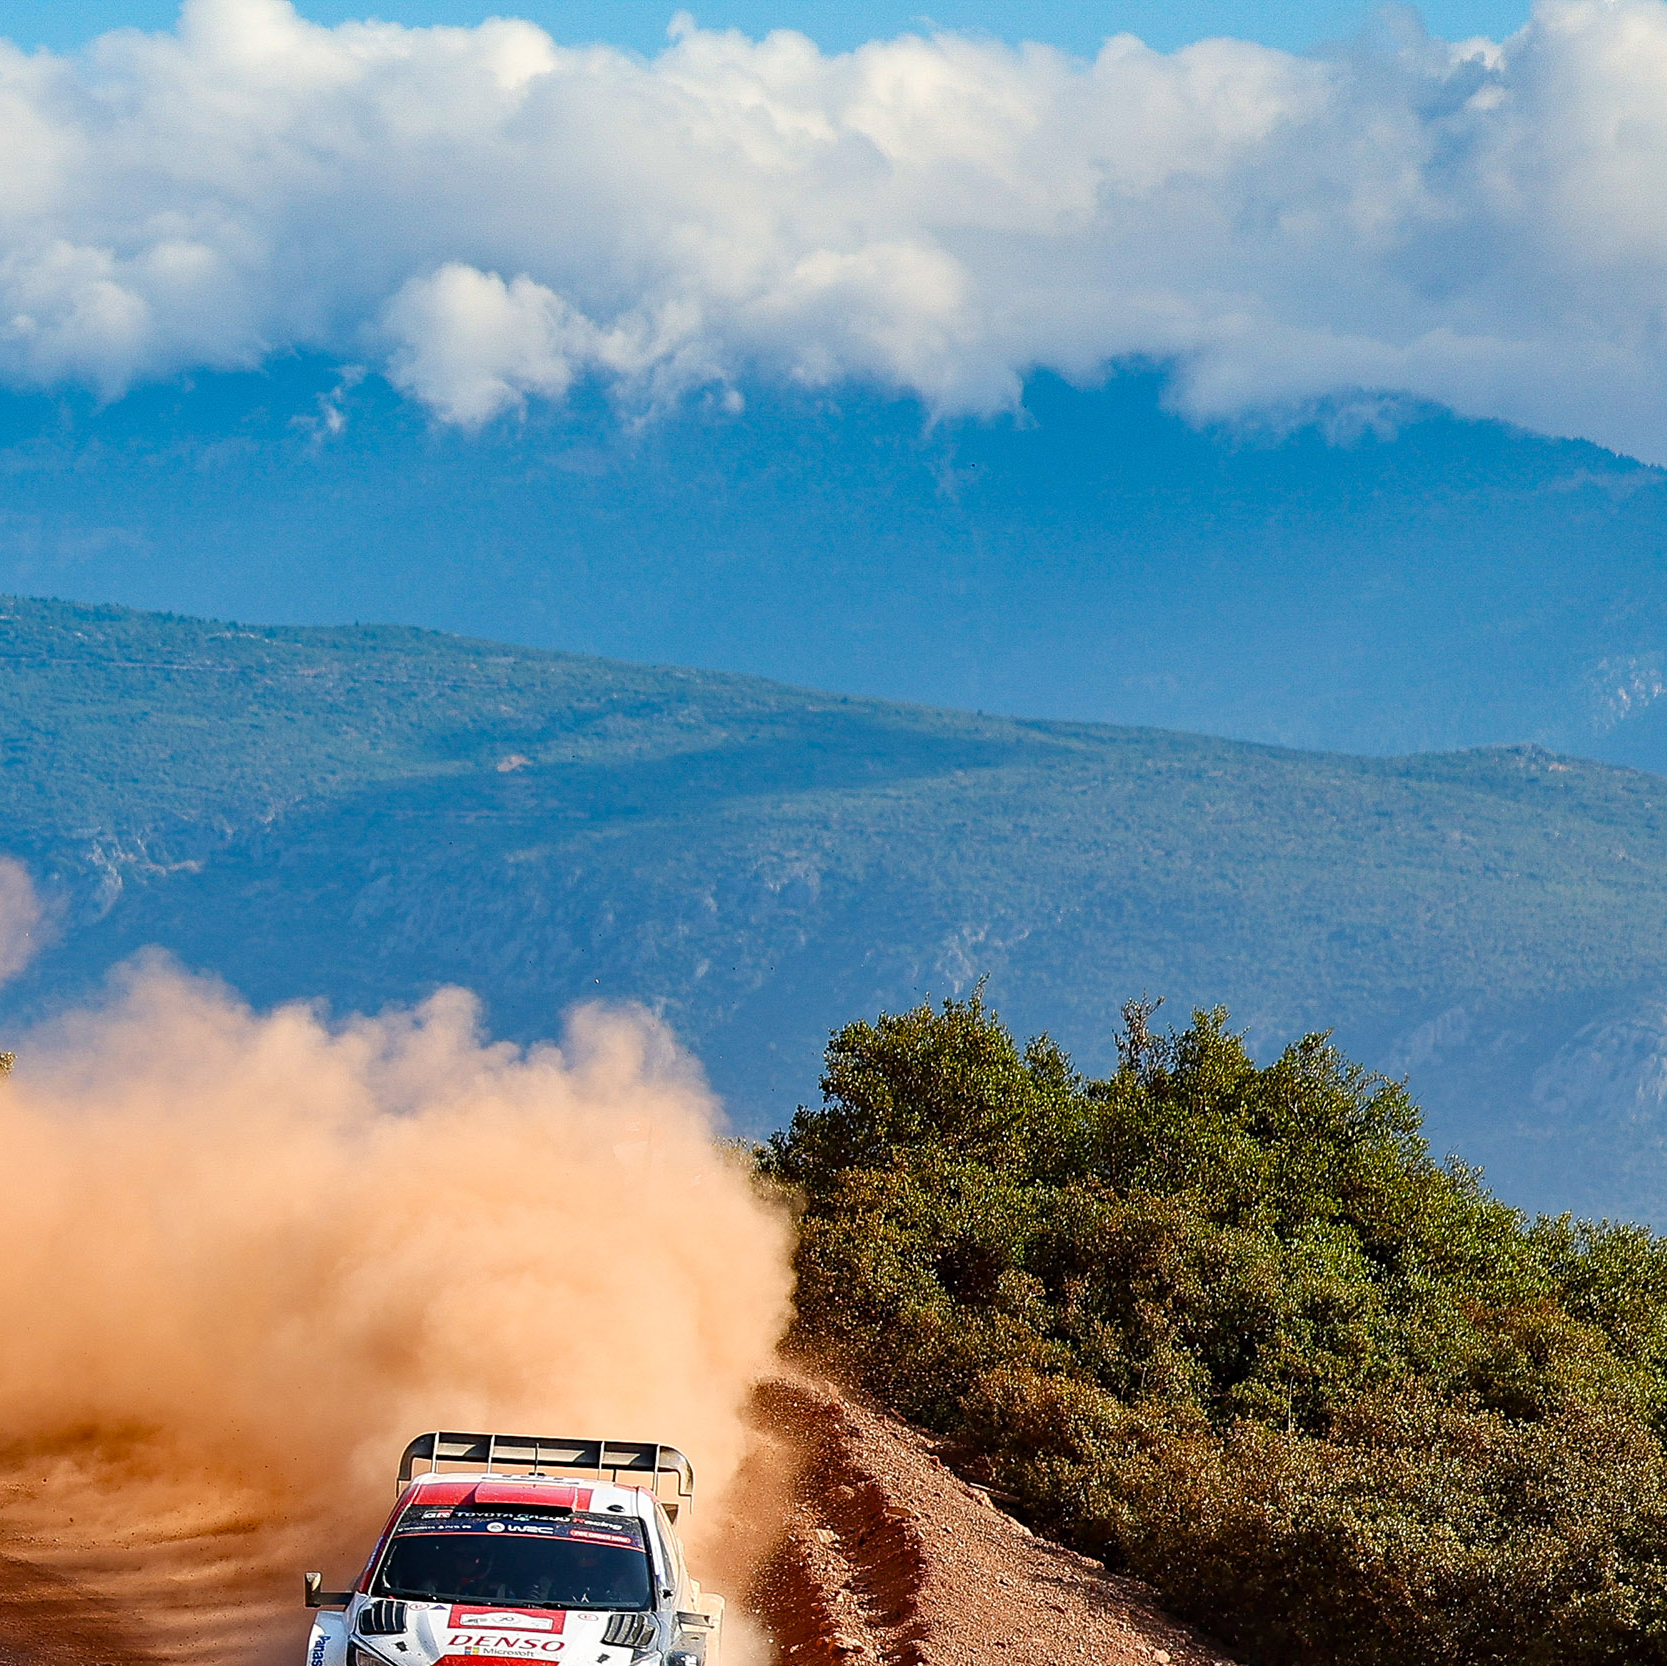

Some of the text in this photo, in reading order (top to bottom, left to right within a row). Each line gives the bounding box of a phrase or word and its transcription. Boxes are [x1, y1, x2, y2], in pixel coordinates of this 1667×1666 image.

[508, 1524, 554, 1535] WRC
[448, 1634, 566, 1652] DENSO
[483, 1647, 535, 1657] Microsoft
